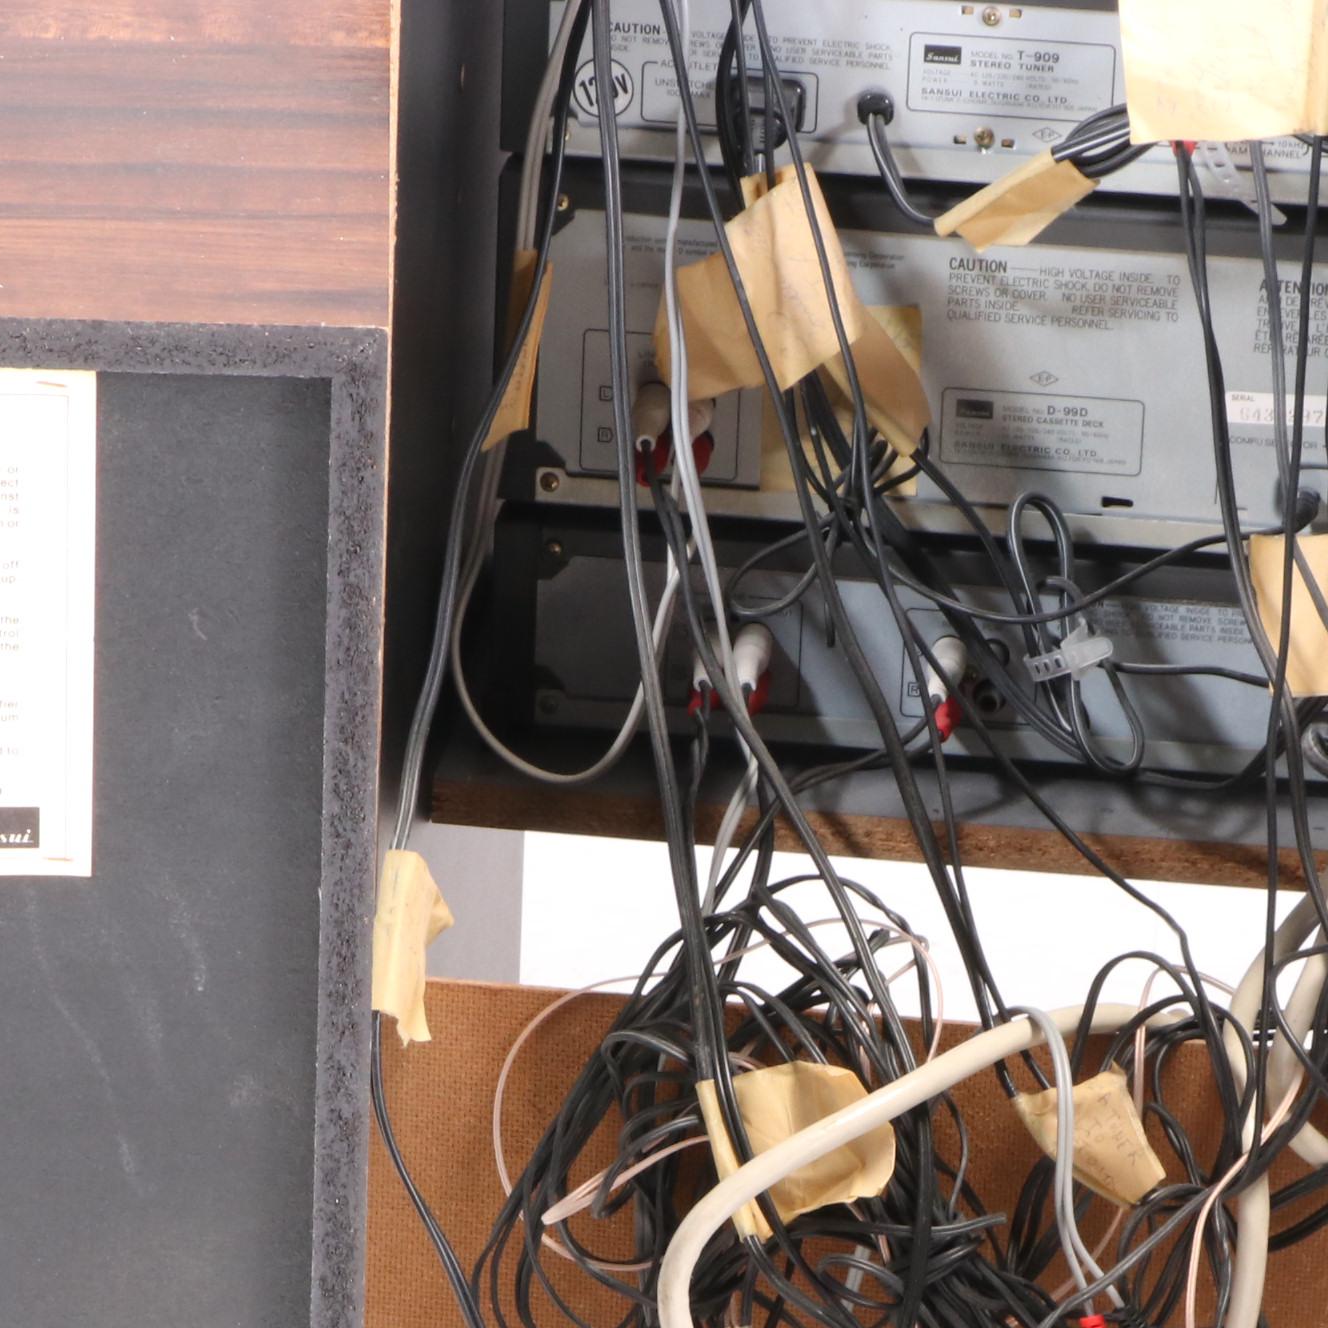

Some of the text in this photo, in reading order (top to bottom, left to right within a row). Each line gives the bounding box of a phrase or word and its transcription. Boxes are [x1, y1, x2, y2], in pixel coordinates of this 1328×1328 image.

[822, 40, 861, 50] ELECTRIC
[970, 50, 997, 60] MODEL
[1017, 50, 1060, 64] T-909
[970, 60, 1055, 73] STEREO TUNER
[921, 87, 1021, 102] SANSUI ELECTRIC
[948, 257, 1008, 273] CAUTION
[1039, 267, 1064, 278] HIGH
[1068, 269, 1114, 282] VOLTAGE
[1167, 275, 1181, 285] TO
[948, 273, 997, 286] PREVENT
[999, 276, 1049, 289] ELECTRIC
[1093, 282, 1108, 293] DO
[1112, 284, 1133, 295] NOT
[1137, 284, 1179, 297] REMOVE
[947, 286, 991, 298] SCREWS
[994, 288, 1009, 299] OR
[1061, 291, 1077, 303] NO
[1080, 293, 1106, 306] USER
[1110, 295, 1178, 310] SERVICEABLE
[946, 309, 1001, 323] QUALIFIED
[1004, 312, 1048, 325] SERVICE
[947, 298, 982, 309] PARTS
[1071, 305, 1105, 317] REFER
[1107, 307, 1161, 322] SERVICING
[1165, 311, 1179, 323] TO
[1047, 405, 1088, 417] D-99D
[1002, 414, 1104, 429] STEREO CASSETTE DECK
[1001, 444, 1051, 455] ELECTRIC
